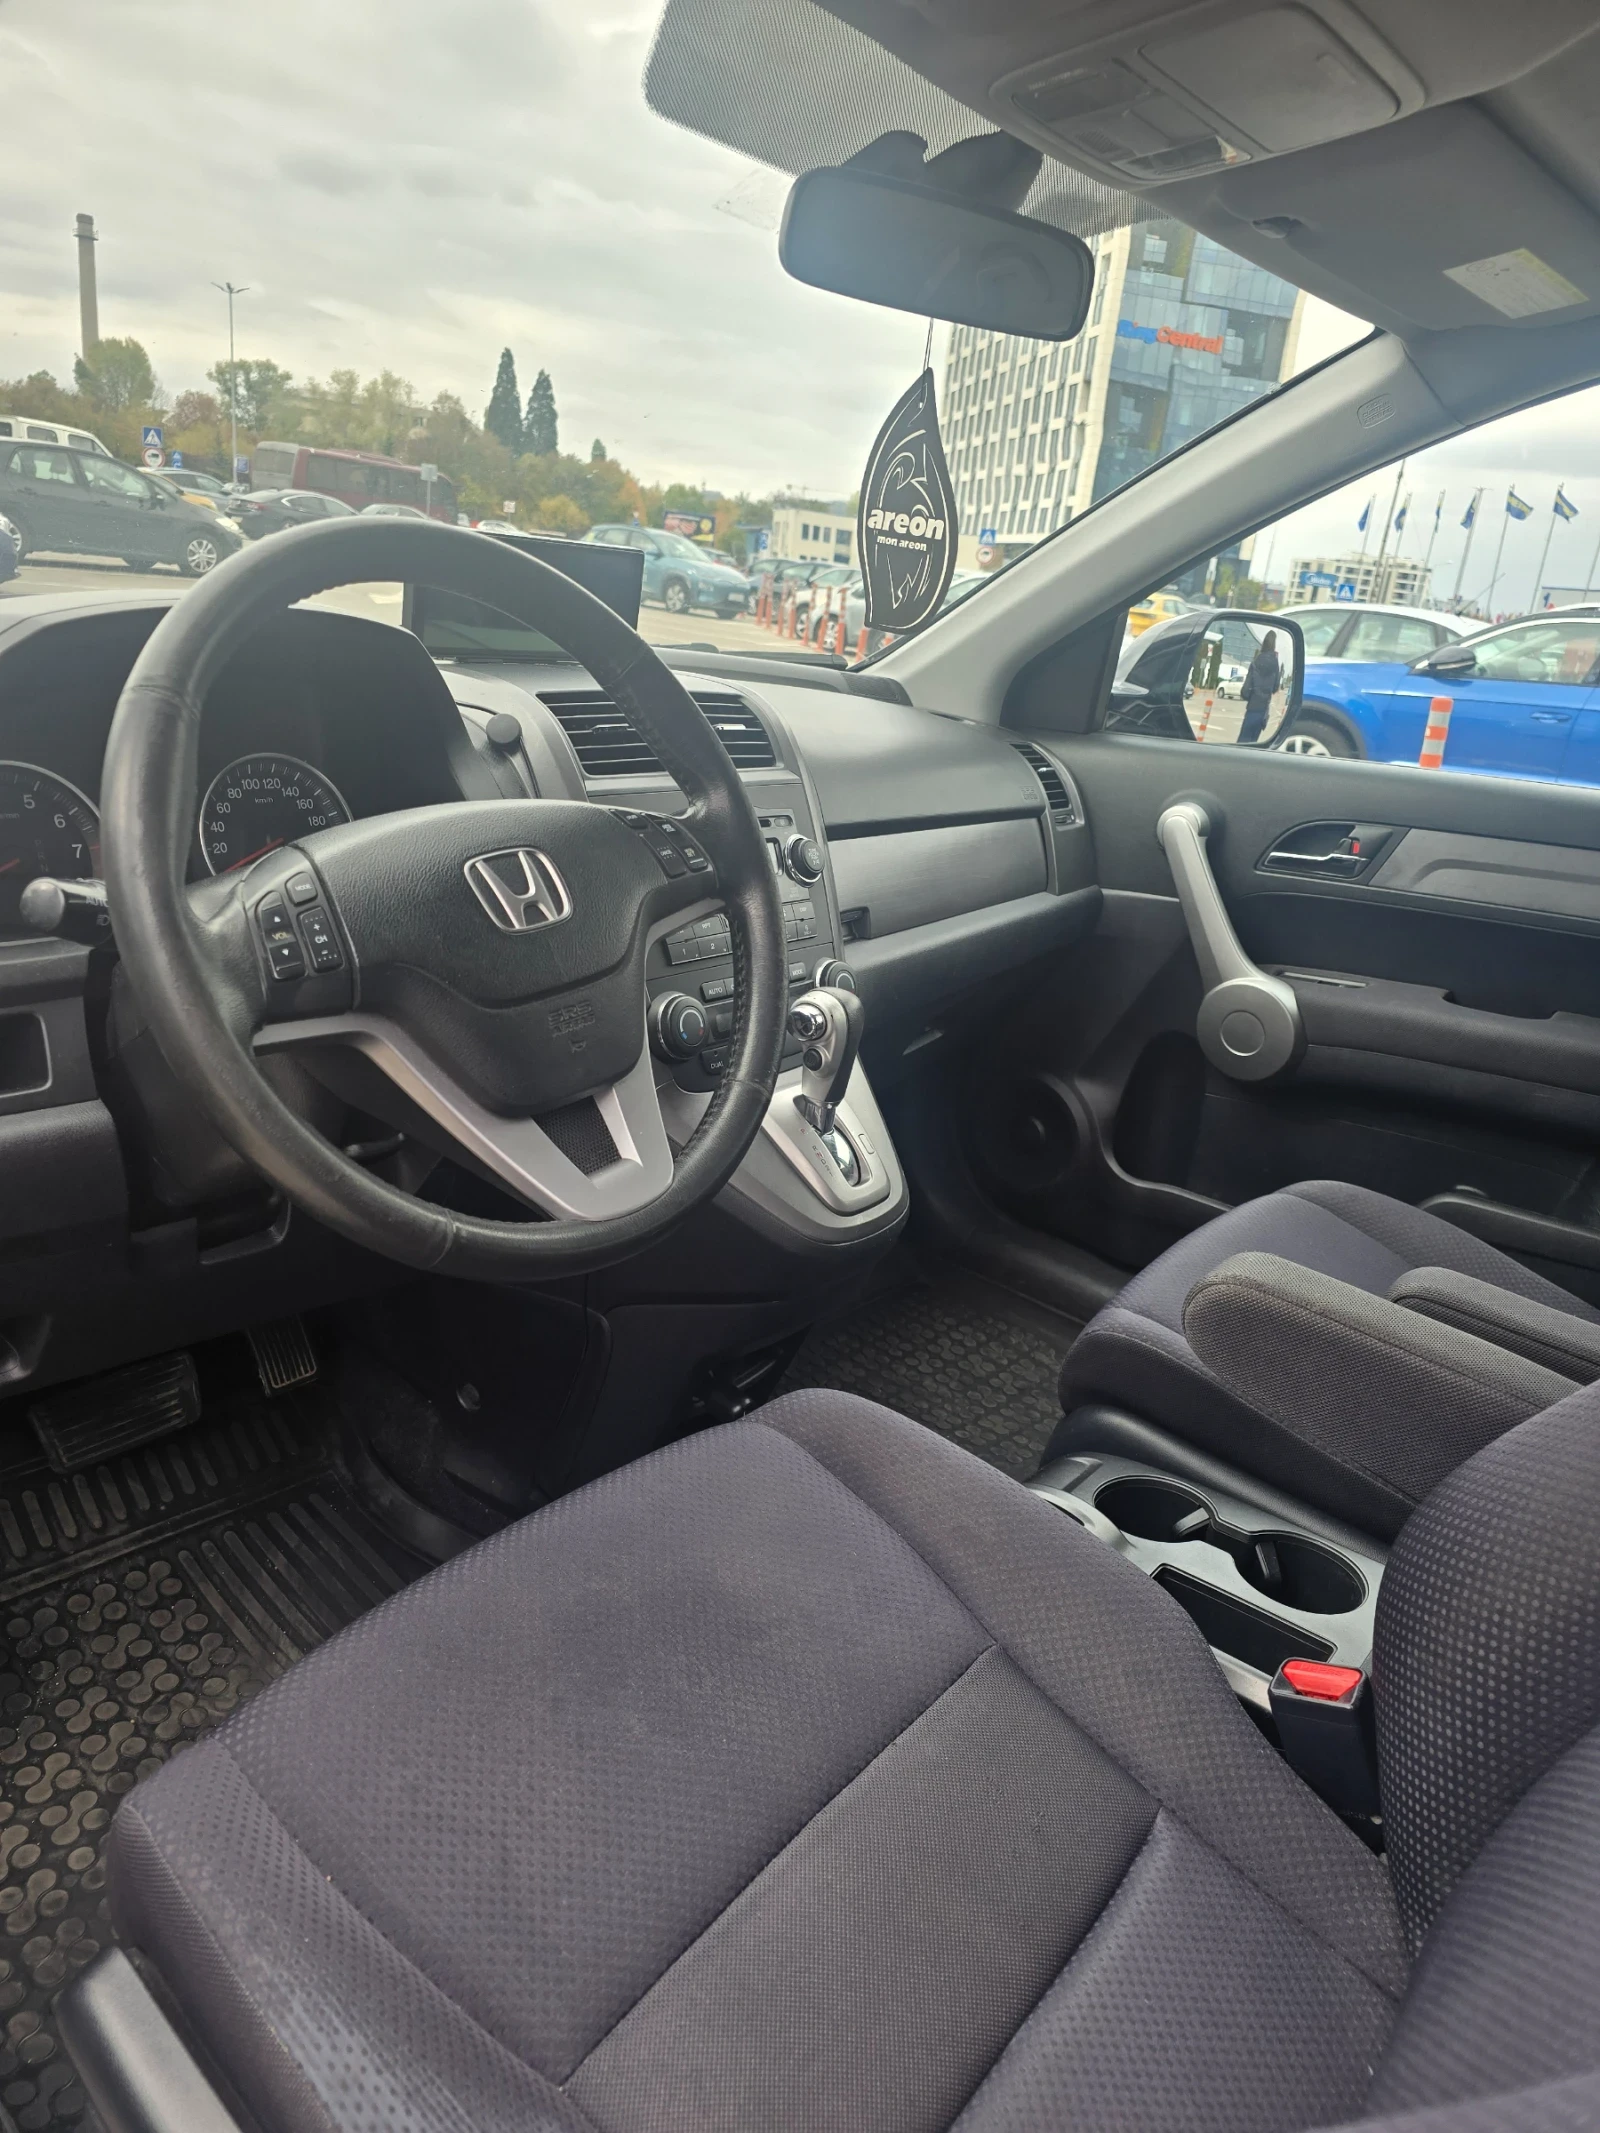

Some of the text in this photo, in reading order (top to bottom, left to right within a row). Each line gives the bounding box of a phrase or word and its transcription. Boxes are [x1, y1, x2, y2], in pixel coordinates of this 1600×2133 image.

[867, 508, 945, 540] areon
[877, 535, 927, 551] mon areon
[241, 778, 260, 790] 100
[263, 778, 281, 789] 120
[227, 788, 242, 799] 80
[282, 787, 299, 798] 140
[23, 794, 35, 809] 5
[296, 799, 314, 810] 160
[216, 802, 231, 813] 60
[53, 814, 66, 828] 6
[210, 821, 225, 832] 40
[308, 816, 326, 827] 180
[71, 843, 82, 859] 7
[212, 842, 228, 854] 20
[314, 933, 328, 944] CH
[708, 987, 723, 995] AUTO
